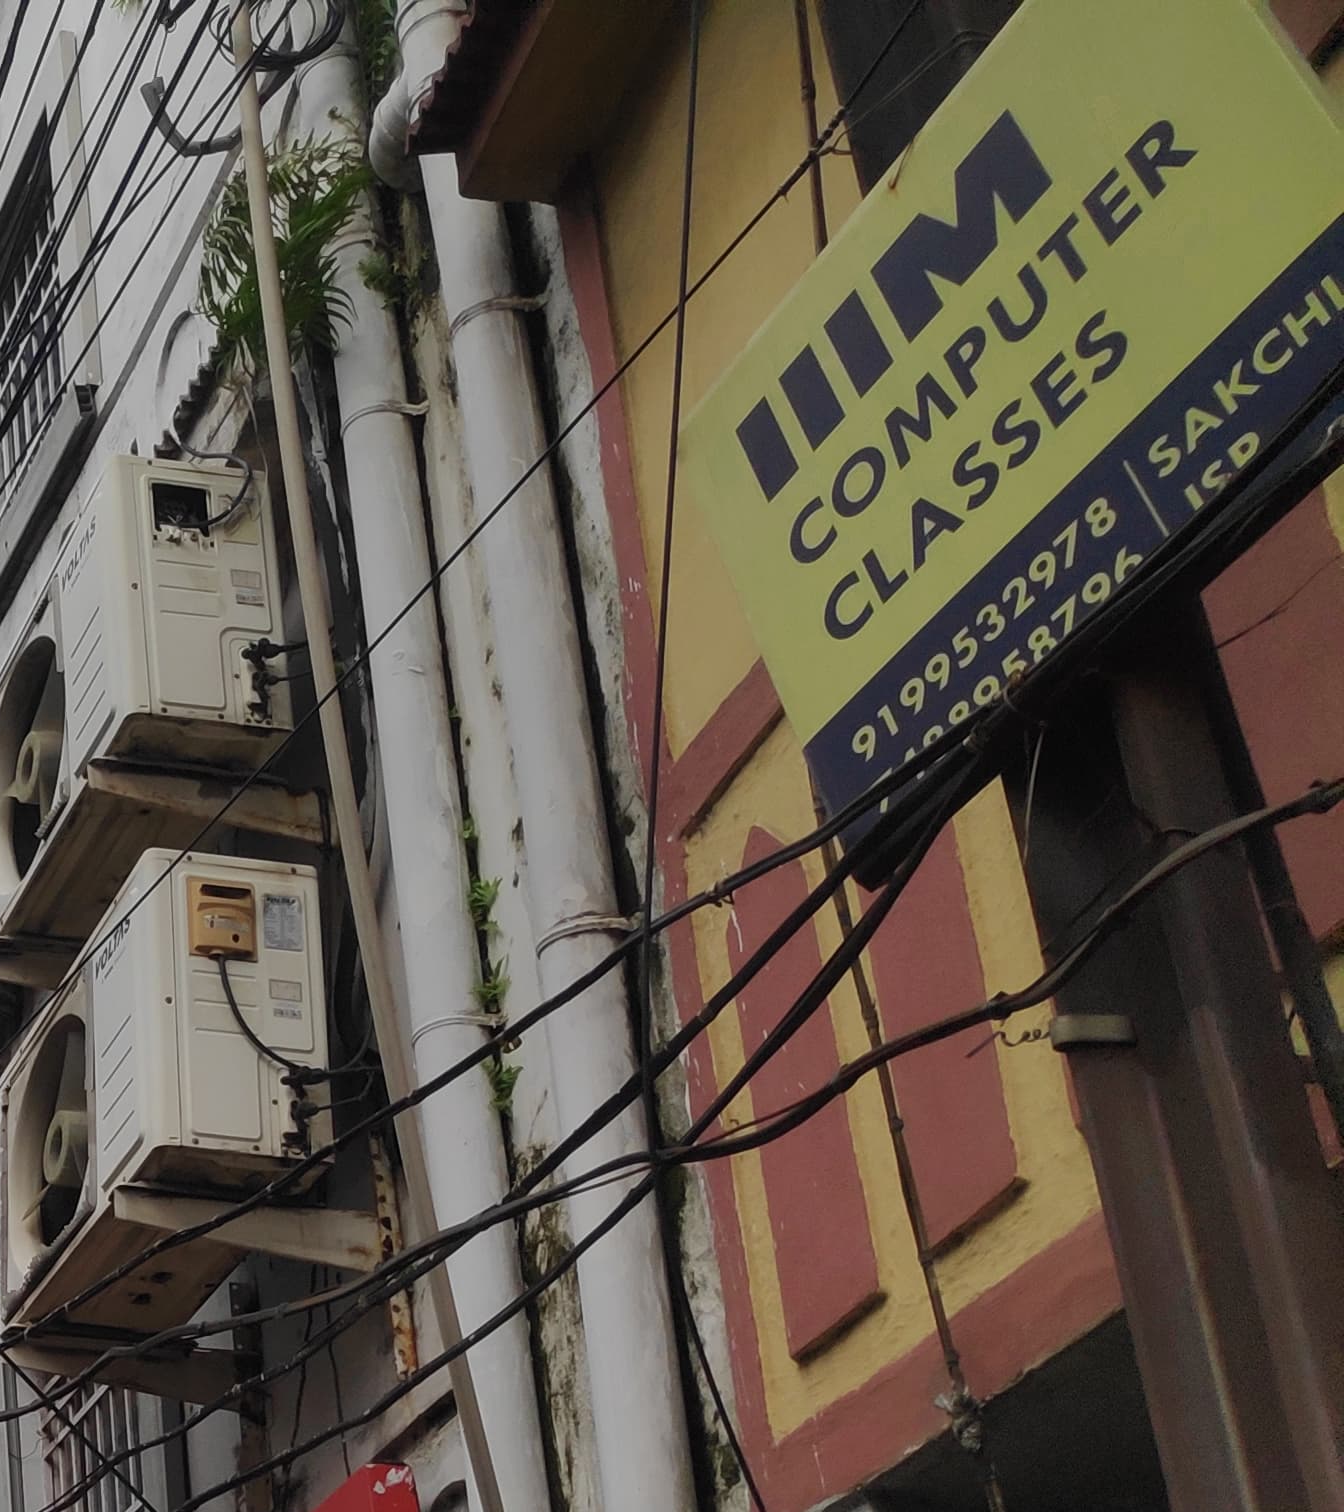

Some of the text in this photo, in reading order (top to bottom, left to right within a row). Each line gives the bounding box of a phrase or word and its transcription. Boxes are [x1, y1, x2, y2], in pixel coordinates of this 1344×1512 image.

[789, 119, 1198, 563] COMPUTER
[61, 514, 96, 593] VOLTAS
[823, 309, 1128, 641] CLASSES
[851, 497, 1116, 762] 9199532978
[95, 918, 130, 980] VOLTAS
